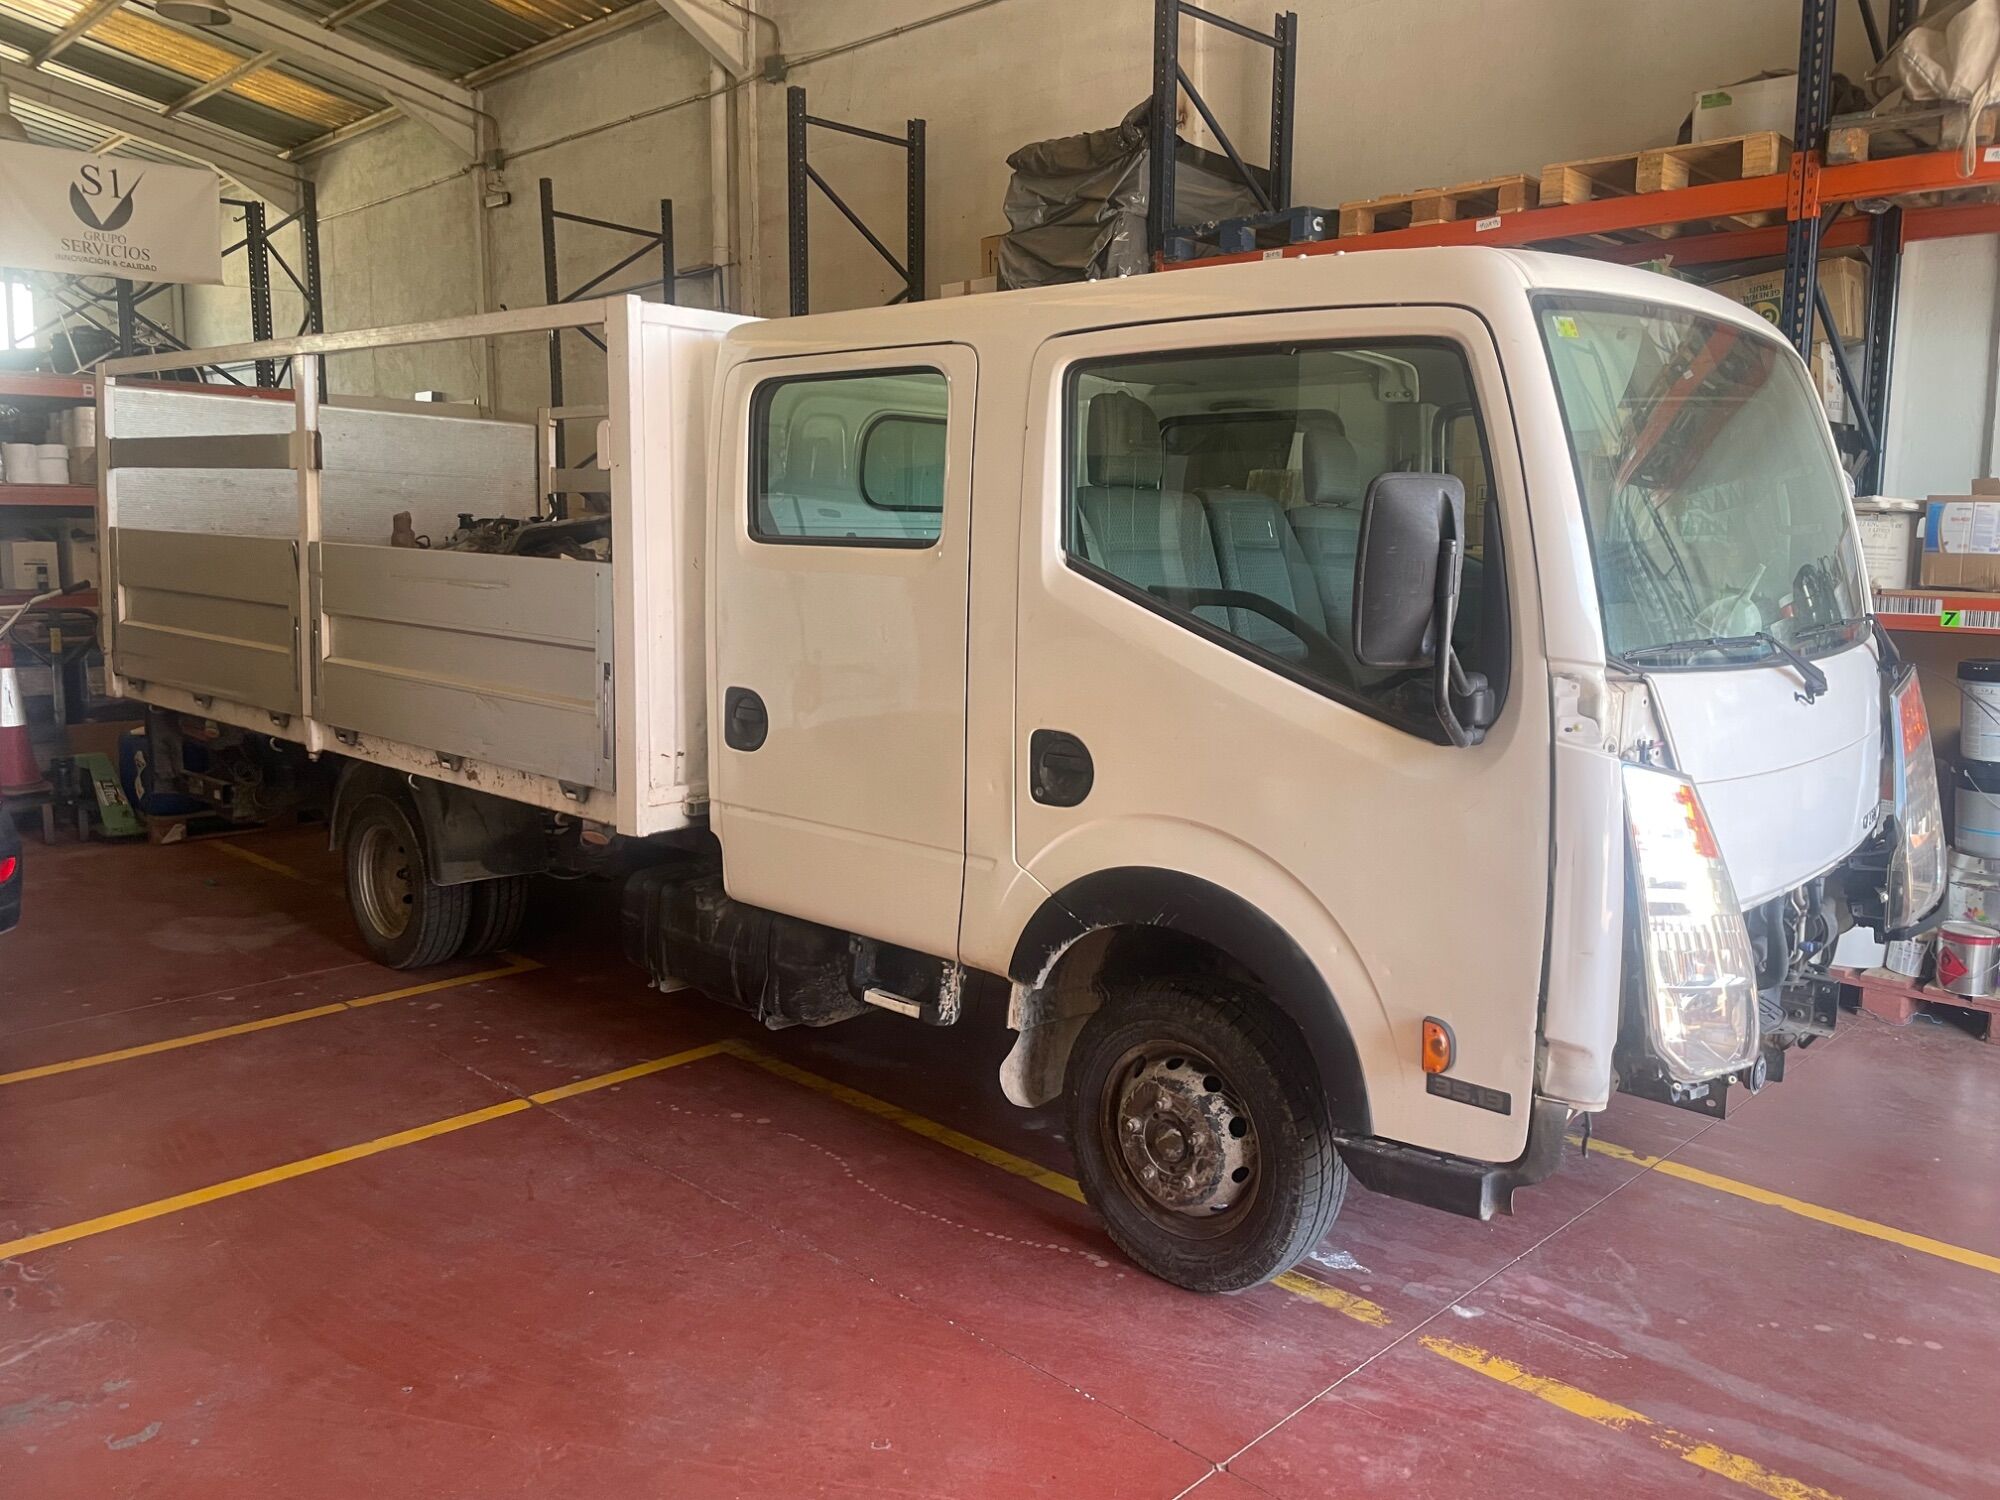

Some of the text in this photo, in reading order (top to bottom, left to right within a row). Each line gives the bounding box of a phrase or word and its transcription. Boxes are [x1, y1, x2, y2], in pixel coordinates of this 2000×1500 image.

[81, 164, 122, 199] S1
[83, 230, 127, 245] GRUPO
[60, 239, 151, 262] SERVICIOS
[119, 262, 158, 272] CALIDAD
[83, 384, 95, 397] B
[1943, 612, 1958, 625] 7
[1433, 1076, 1505, 1110] 35.13
